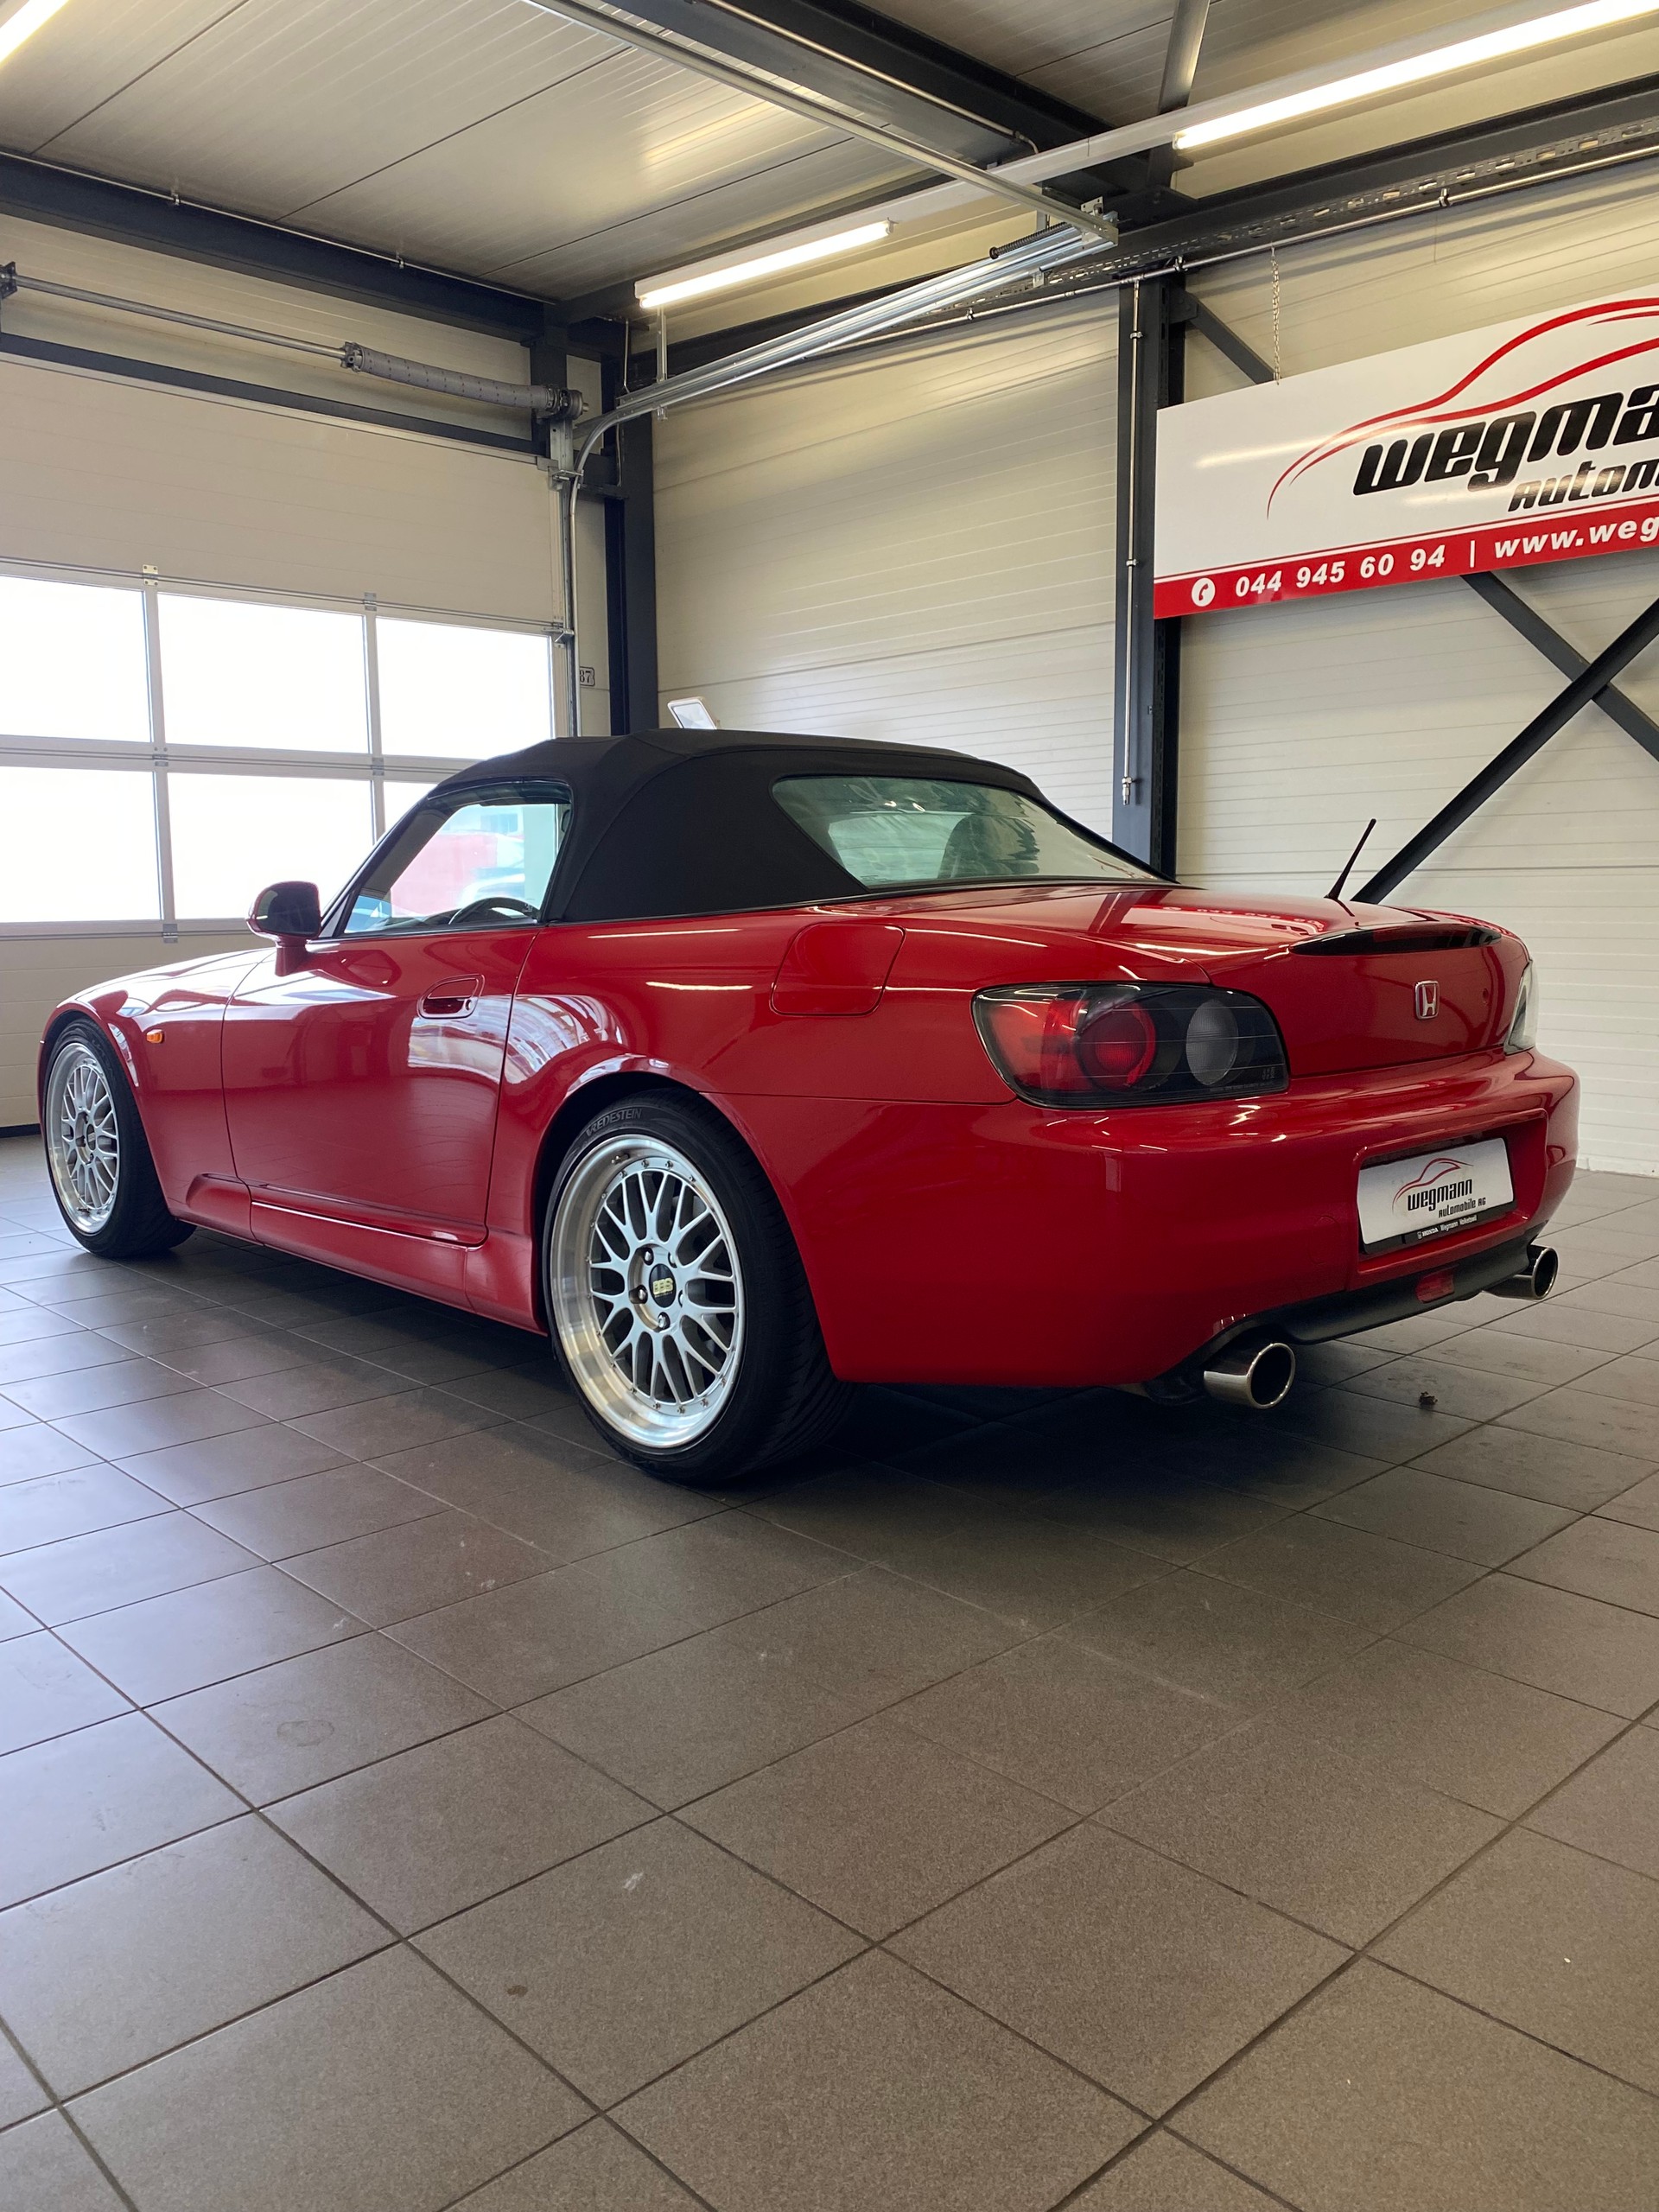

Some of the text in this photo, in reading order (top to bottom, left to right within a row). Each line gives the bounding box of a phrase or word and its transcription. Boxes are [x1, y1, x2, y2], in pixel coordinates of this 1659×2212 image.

[1353, 384, 1659, 496] wegma
[1236, 517, 1659, 597] 044 945 60 94 www.weg
[586, 1108, 642, 1137] VREDESTEIN
[1408, 1179, 1472, 1211] wegmann
[1478, 1198, 1486, 1207] AG
[1422, 1227, 1439, 1236] HONDA
[653, 1277, 674, 1295] BBS
